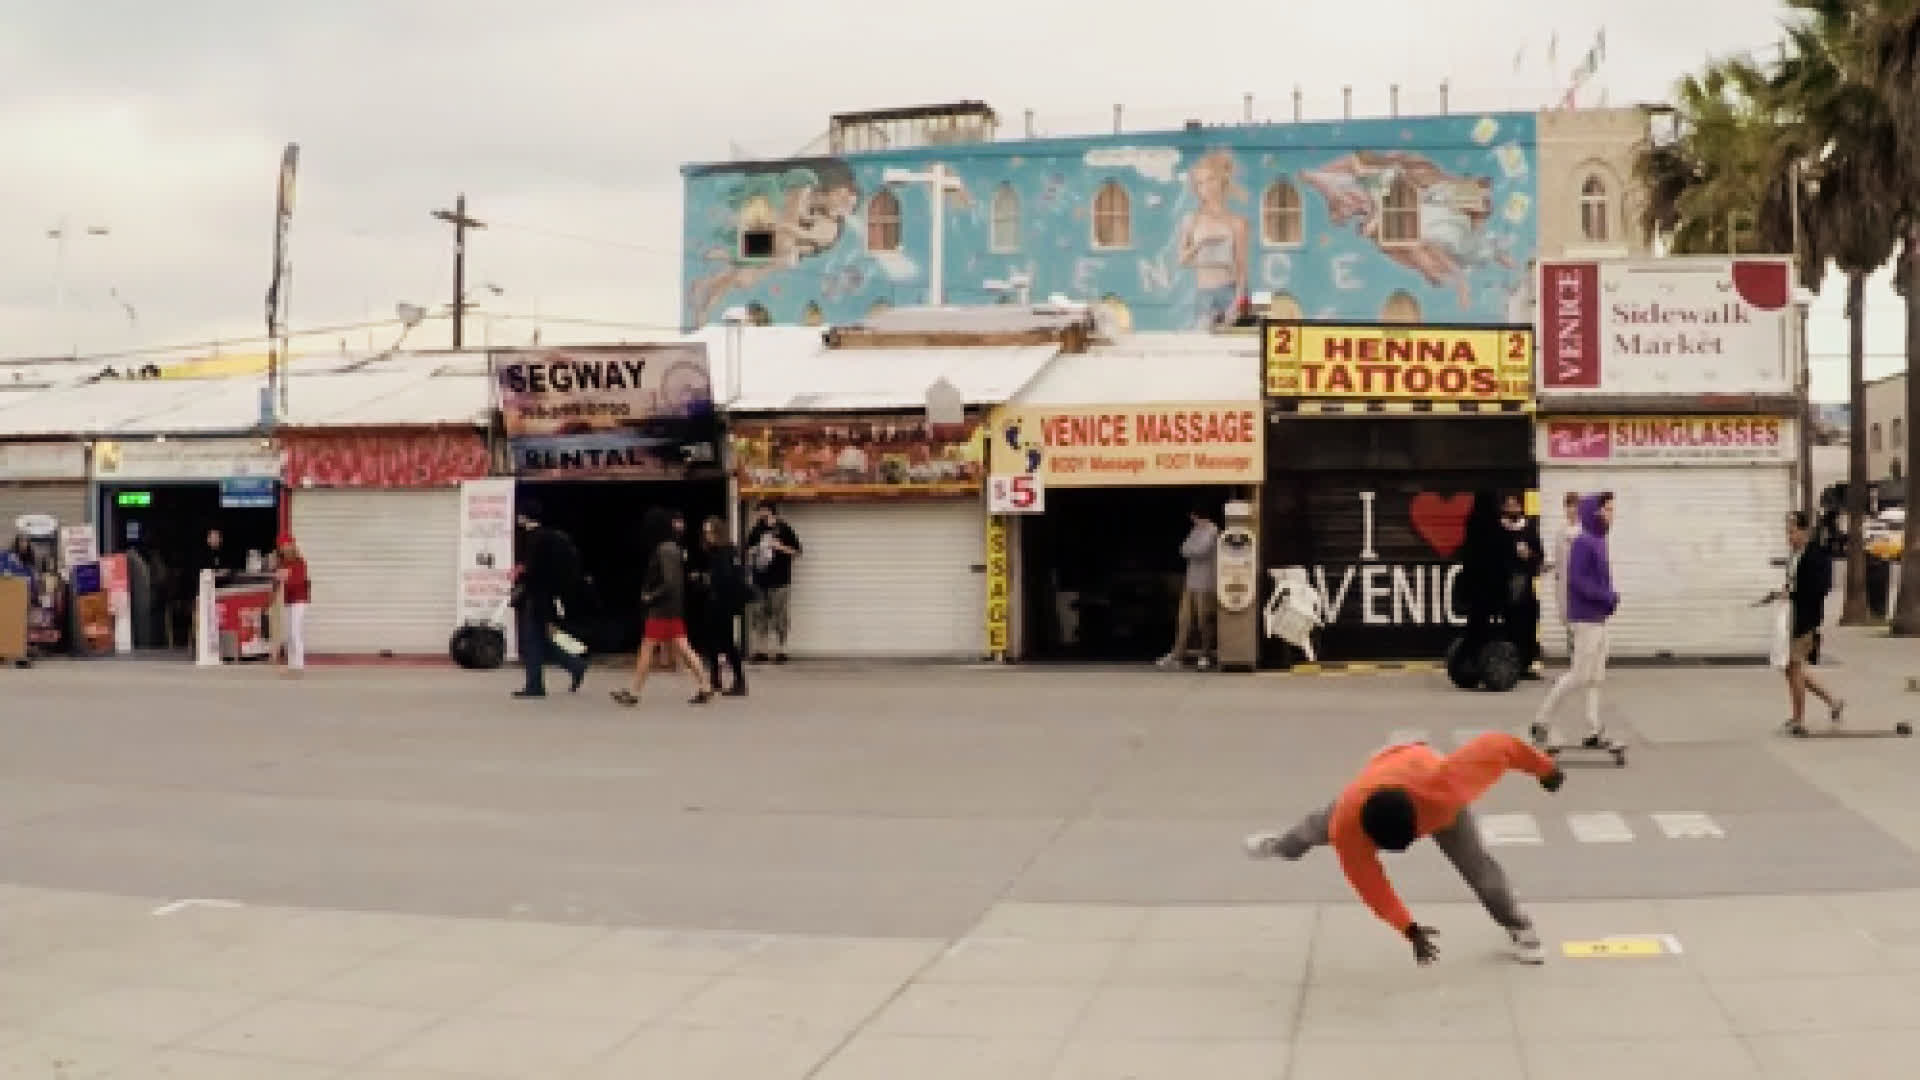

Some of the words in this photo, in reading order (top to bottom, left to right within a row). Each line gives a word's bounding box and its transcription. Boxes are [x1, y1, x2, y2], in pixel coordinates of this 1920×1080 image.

[1558, 267, 1584, 382] VENICE
[1611, 301, 1752, 325] Sidewalk
[1273, 327, 1294, 355] 2
[1323, 336, 1478, 362] HENNA
[1507, 332, 1526, 359] 2
[1612, 331, 1724, 356] Market
[504, 360, 645, 393] SEGWAY
[1300, 363, 1500, 396] TATTOOS
[1040, 414, 1130, 447] VENICE
[1135, 410, 1256, 444] MASSAGE
[1615, 420, 1780, 447] SUNGLASSES
[524, 448, 646, 470] RENTAL
[1359, 491, 1379, 561] I
[1313, 564, 1468, 624] VENIC
